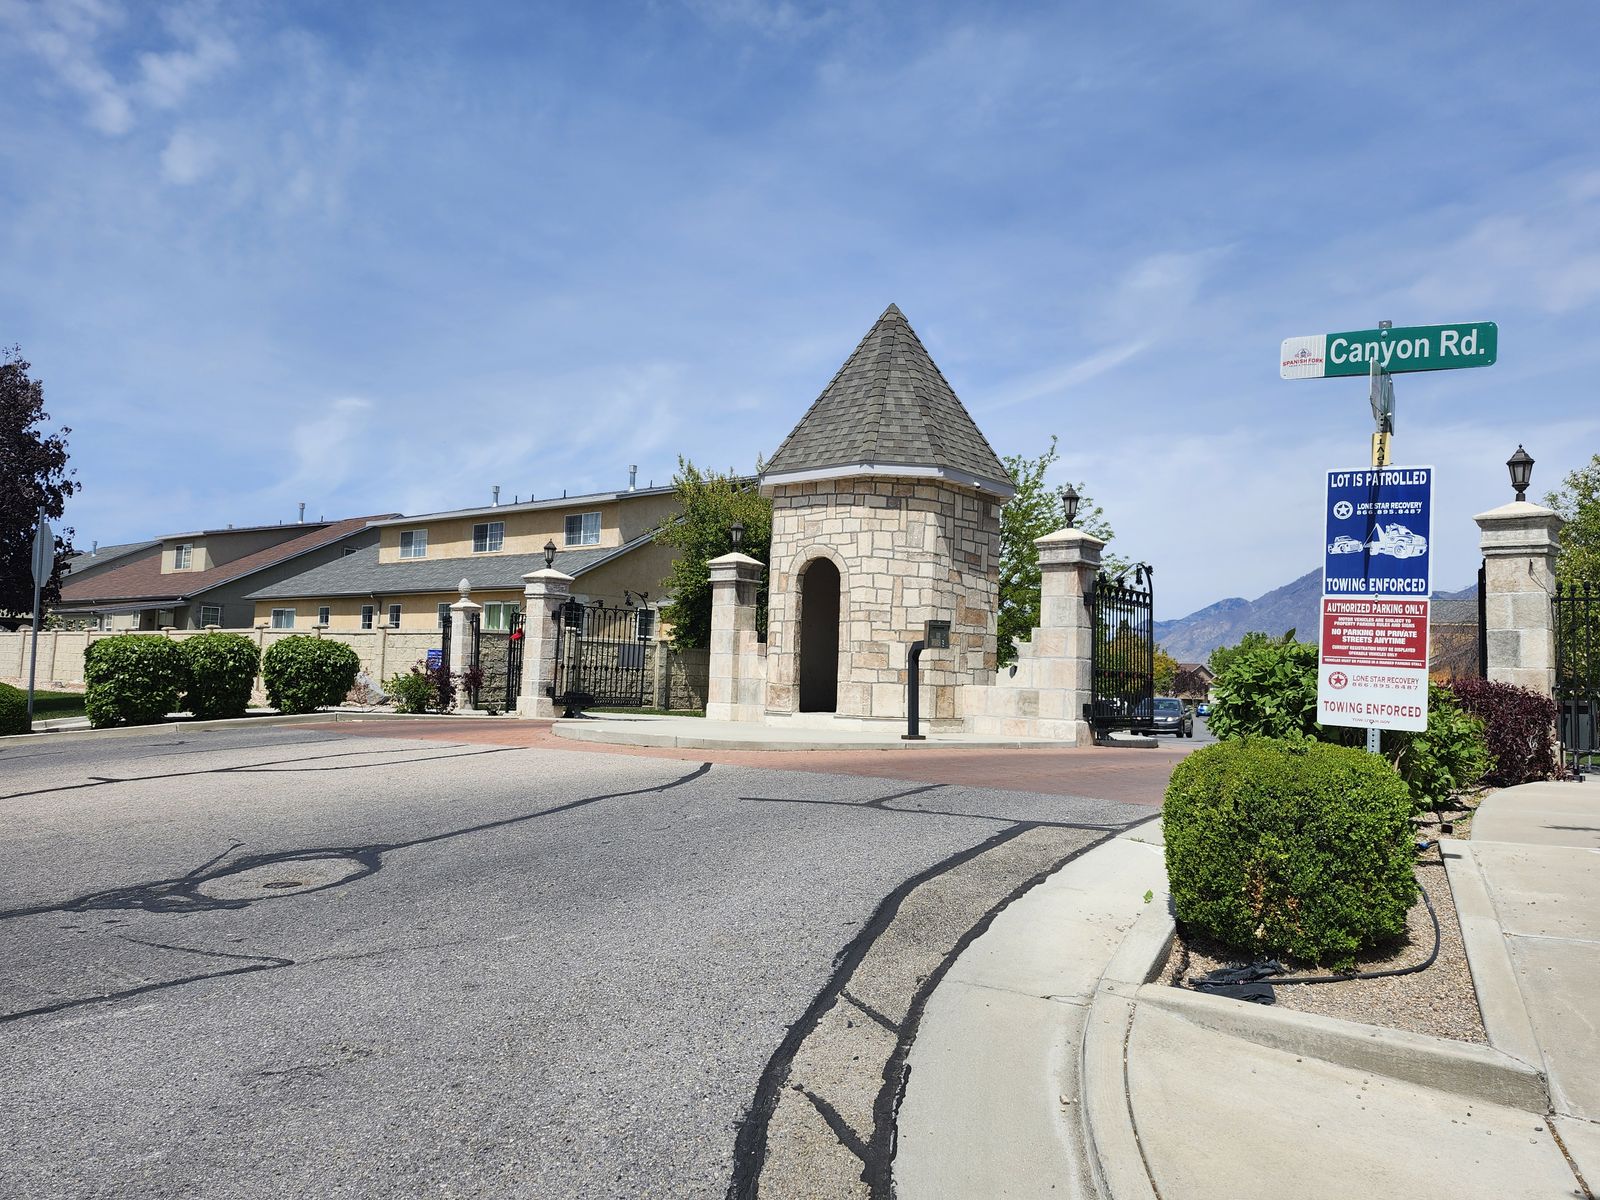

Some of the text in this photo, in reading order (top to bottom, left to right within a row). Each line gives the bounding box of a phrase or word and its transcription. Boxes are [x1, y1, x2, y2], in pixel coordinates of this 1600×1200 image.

[1330, 328, 1485, 368] Canyon Rd.
[1282, 358, 1307, 366] SPANISH
[1331, 471, 1427, 488] LOT IS PATROLLED
[1357, 502, 1373, 510] LONE
[1390, 501, 1422, 509] RECOVERY
[1327, 578, 1426, 592] TOWING ENFORCED
[1327, 602, 1424, 615] AUTHORIZED PARKING ONLY
[1387, 630, 1418, 638] PRIVATE
[1352, 674, 1369, 682] LONE
[1369, 675, 1386, 683] STAR
[1387, 676, 1419, 685] RECOVERY
[1352, 682, 1418, 690] 866.895.8487
[1324, 700, 1421, 718] TOWING ENFORCED
